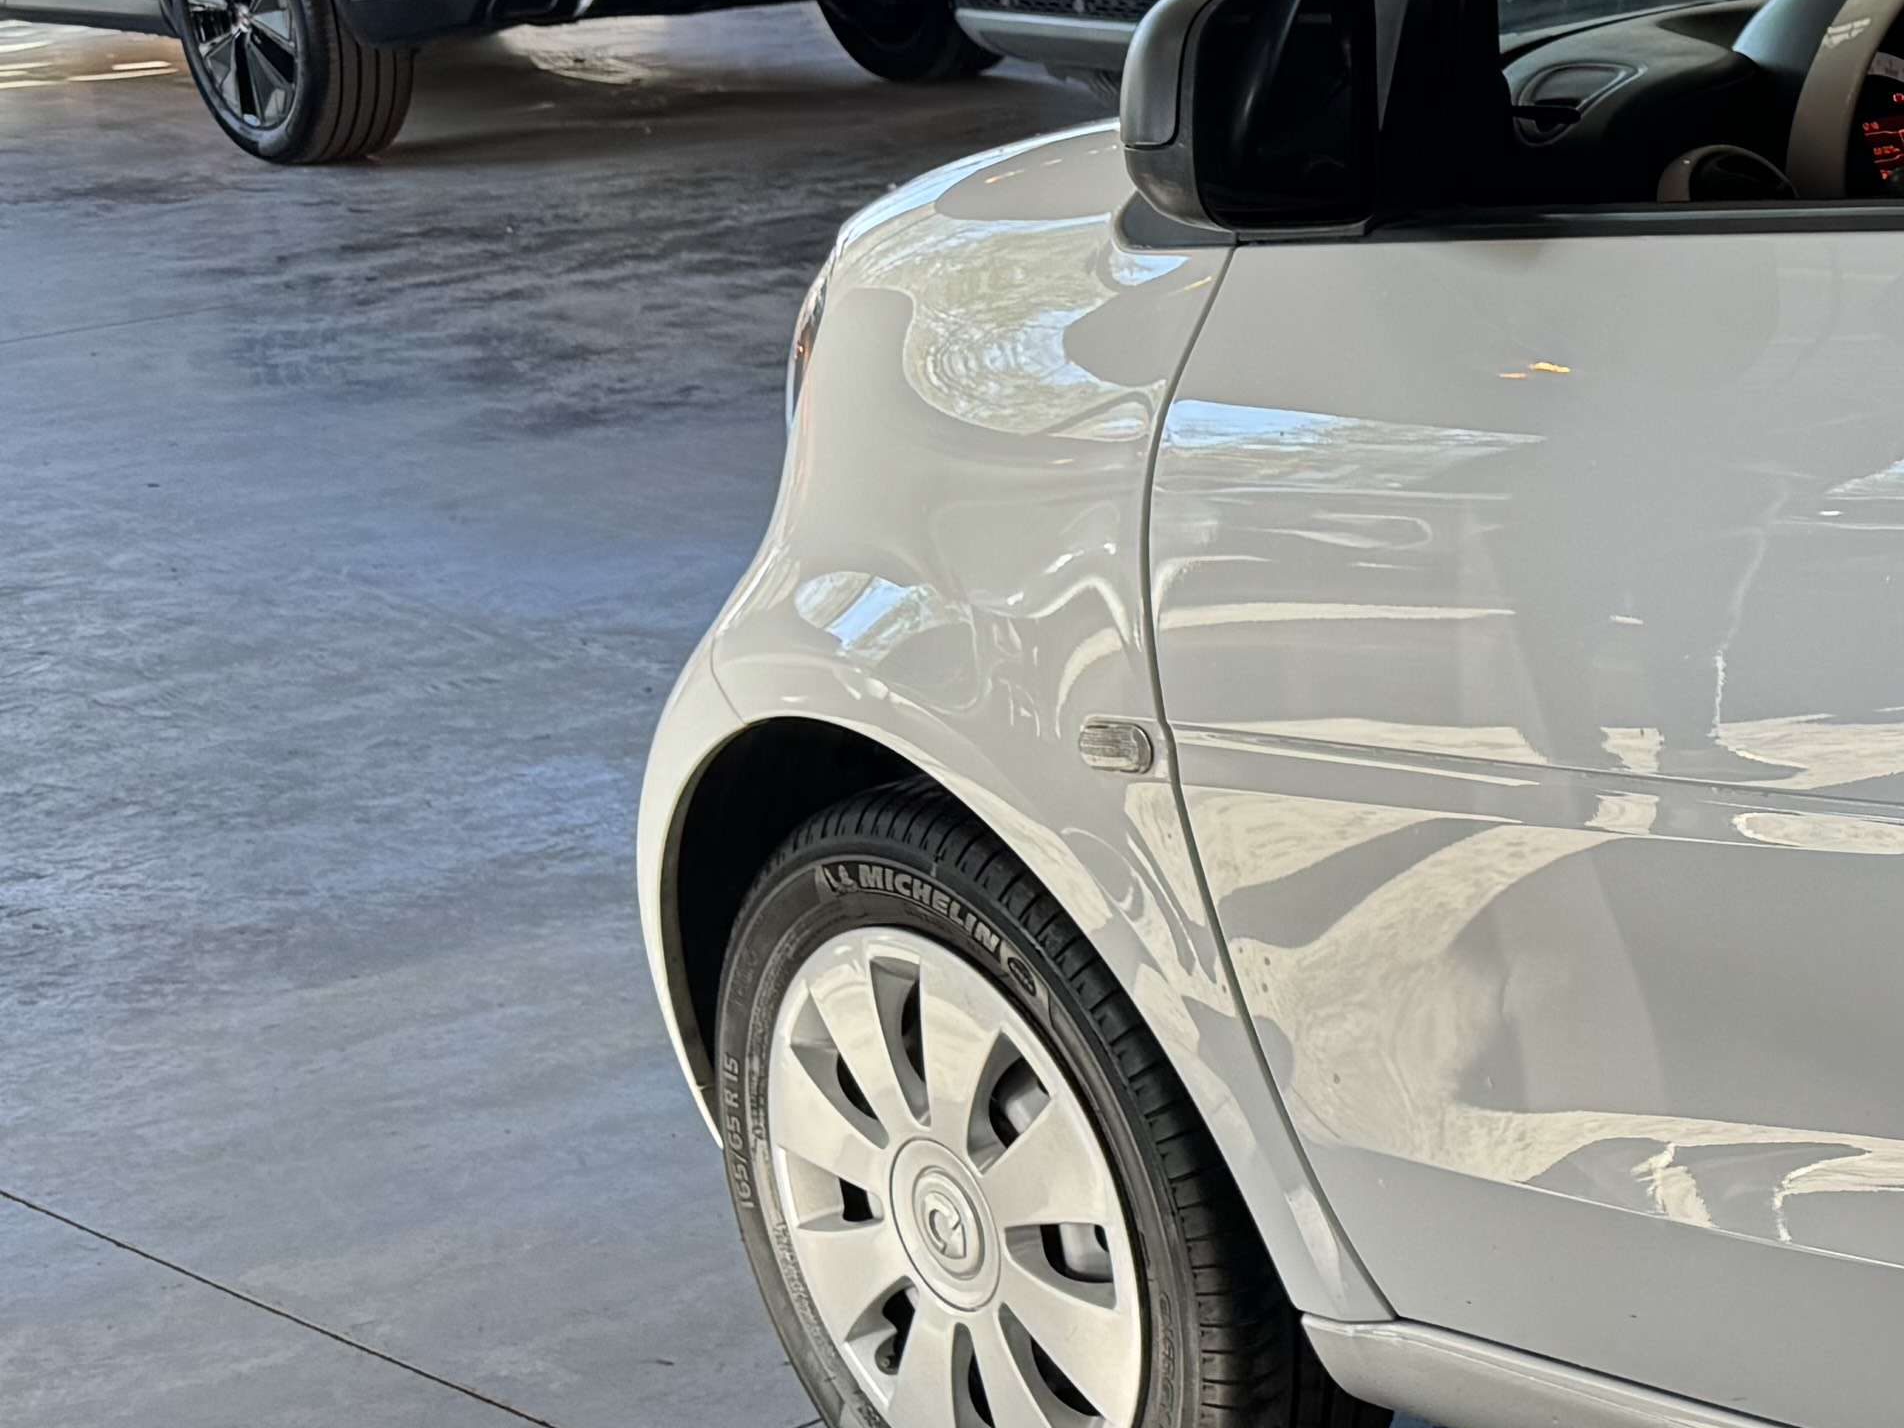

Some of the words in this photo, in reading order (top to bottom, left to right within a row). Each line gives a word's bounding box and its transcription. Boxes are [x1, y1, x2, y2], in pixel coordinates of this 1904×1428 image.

[857, 863, 1003, 956] MICHELIN
[724, 1053, 739, 1082] 15
[724, 1089, 739, 1108] R
[727, 1115, 754, 1208] 165/65
